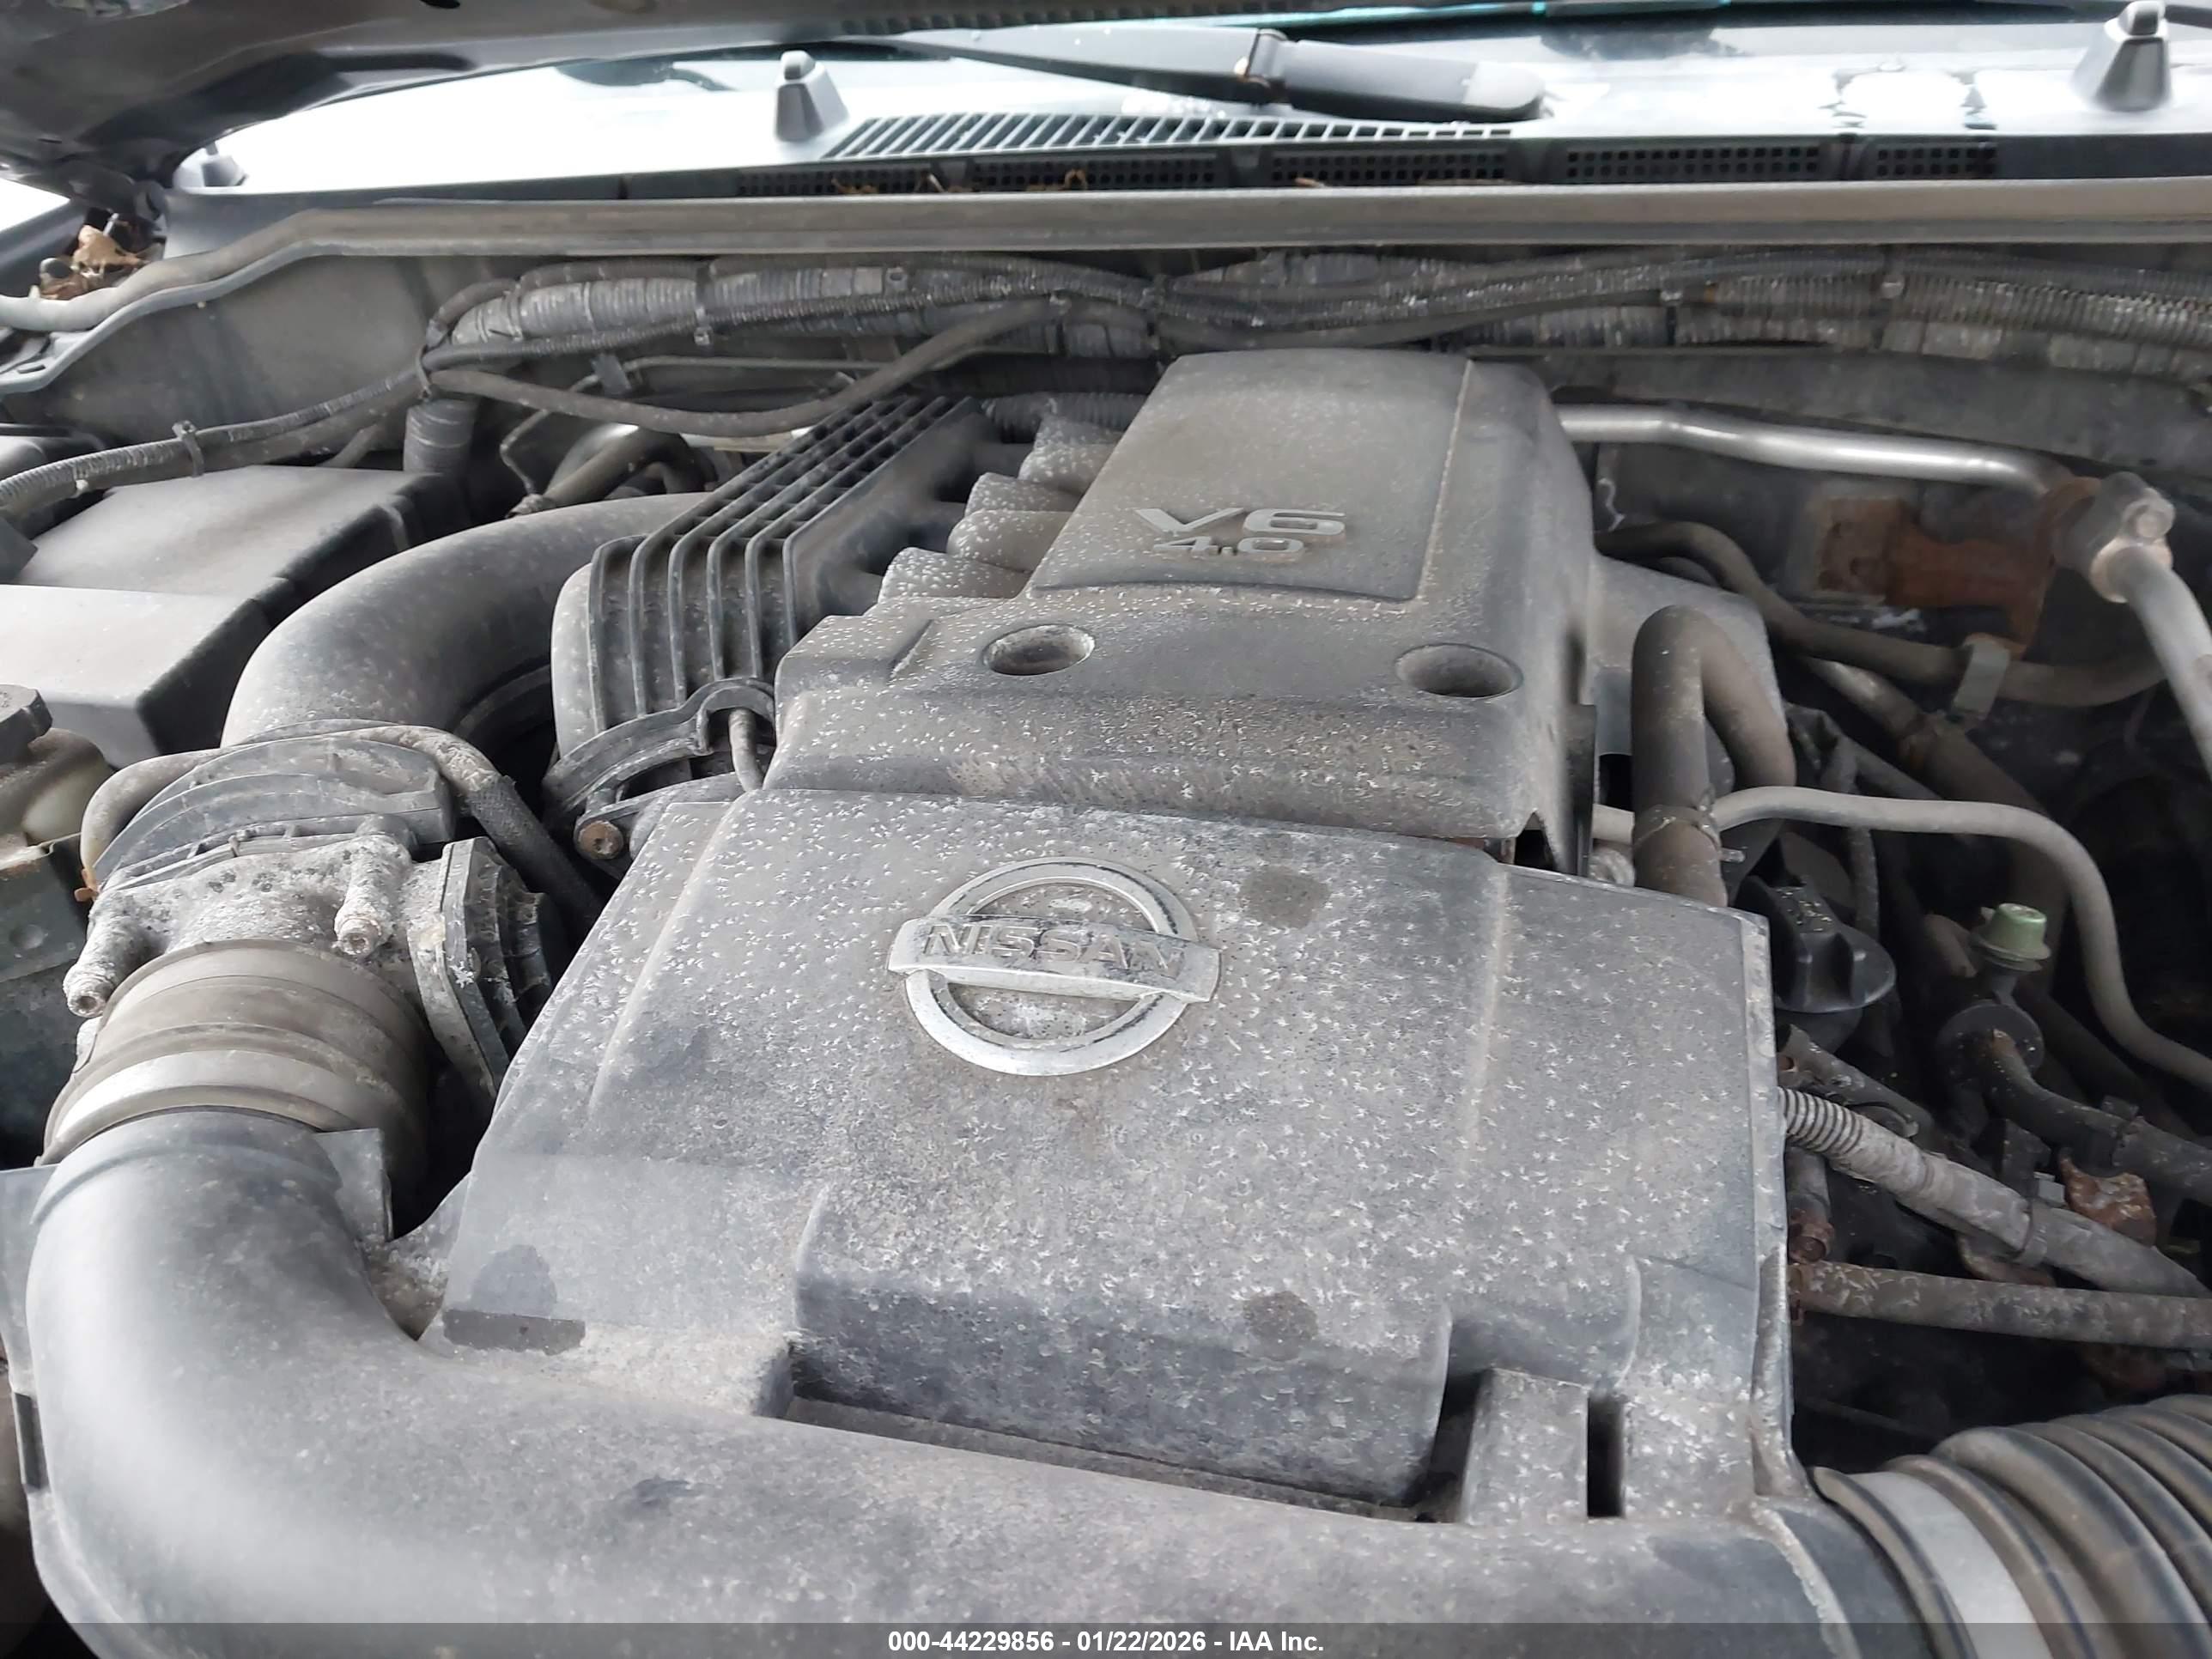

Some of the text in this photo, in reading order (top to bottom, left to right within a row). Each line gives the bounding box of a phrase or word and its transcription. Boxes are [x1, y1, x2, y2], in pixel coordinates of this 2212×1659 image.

[1134, 507, 1346, 535] V6
[1153, 536, 1304, 555] 4.0
[921, 923, 1187, 981] NISSAN
